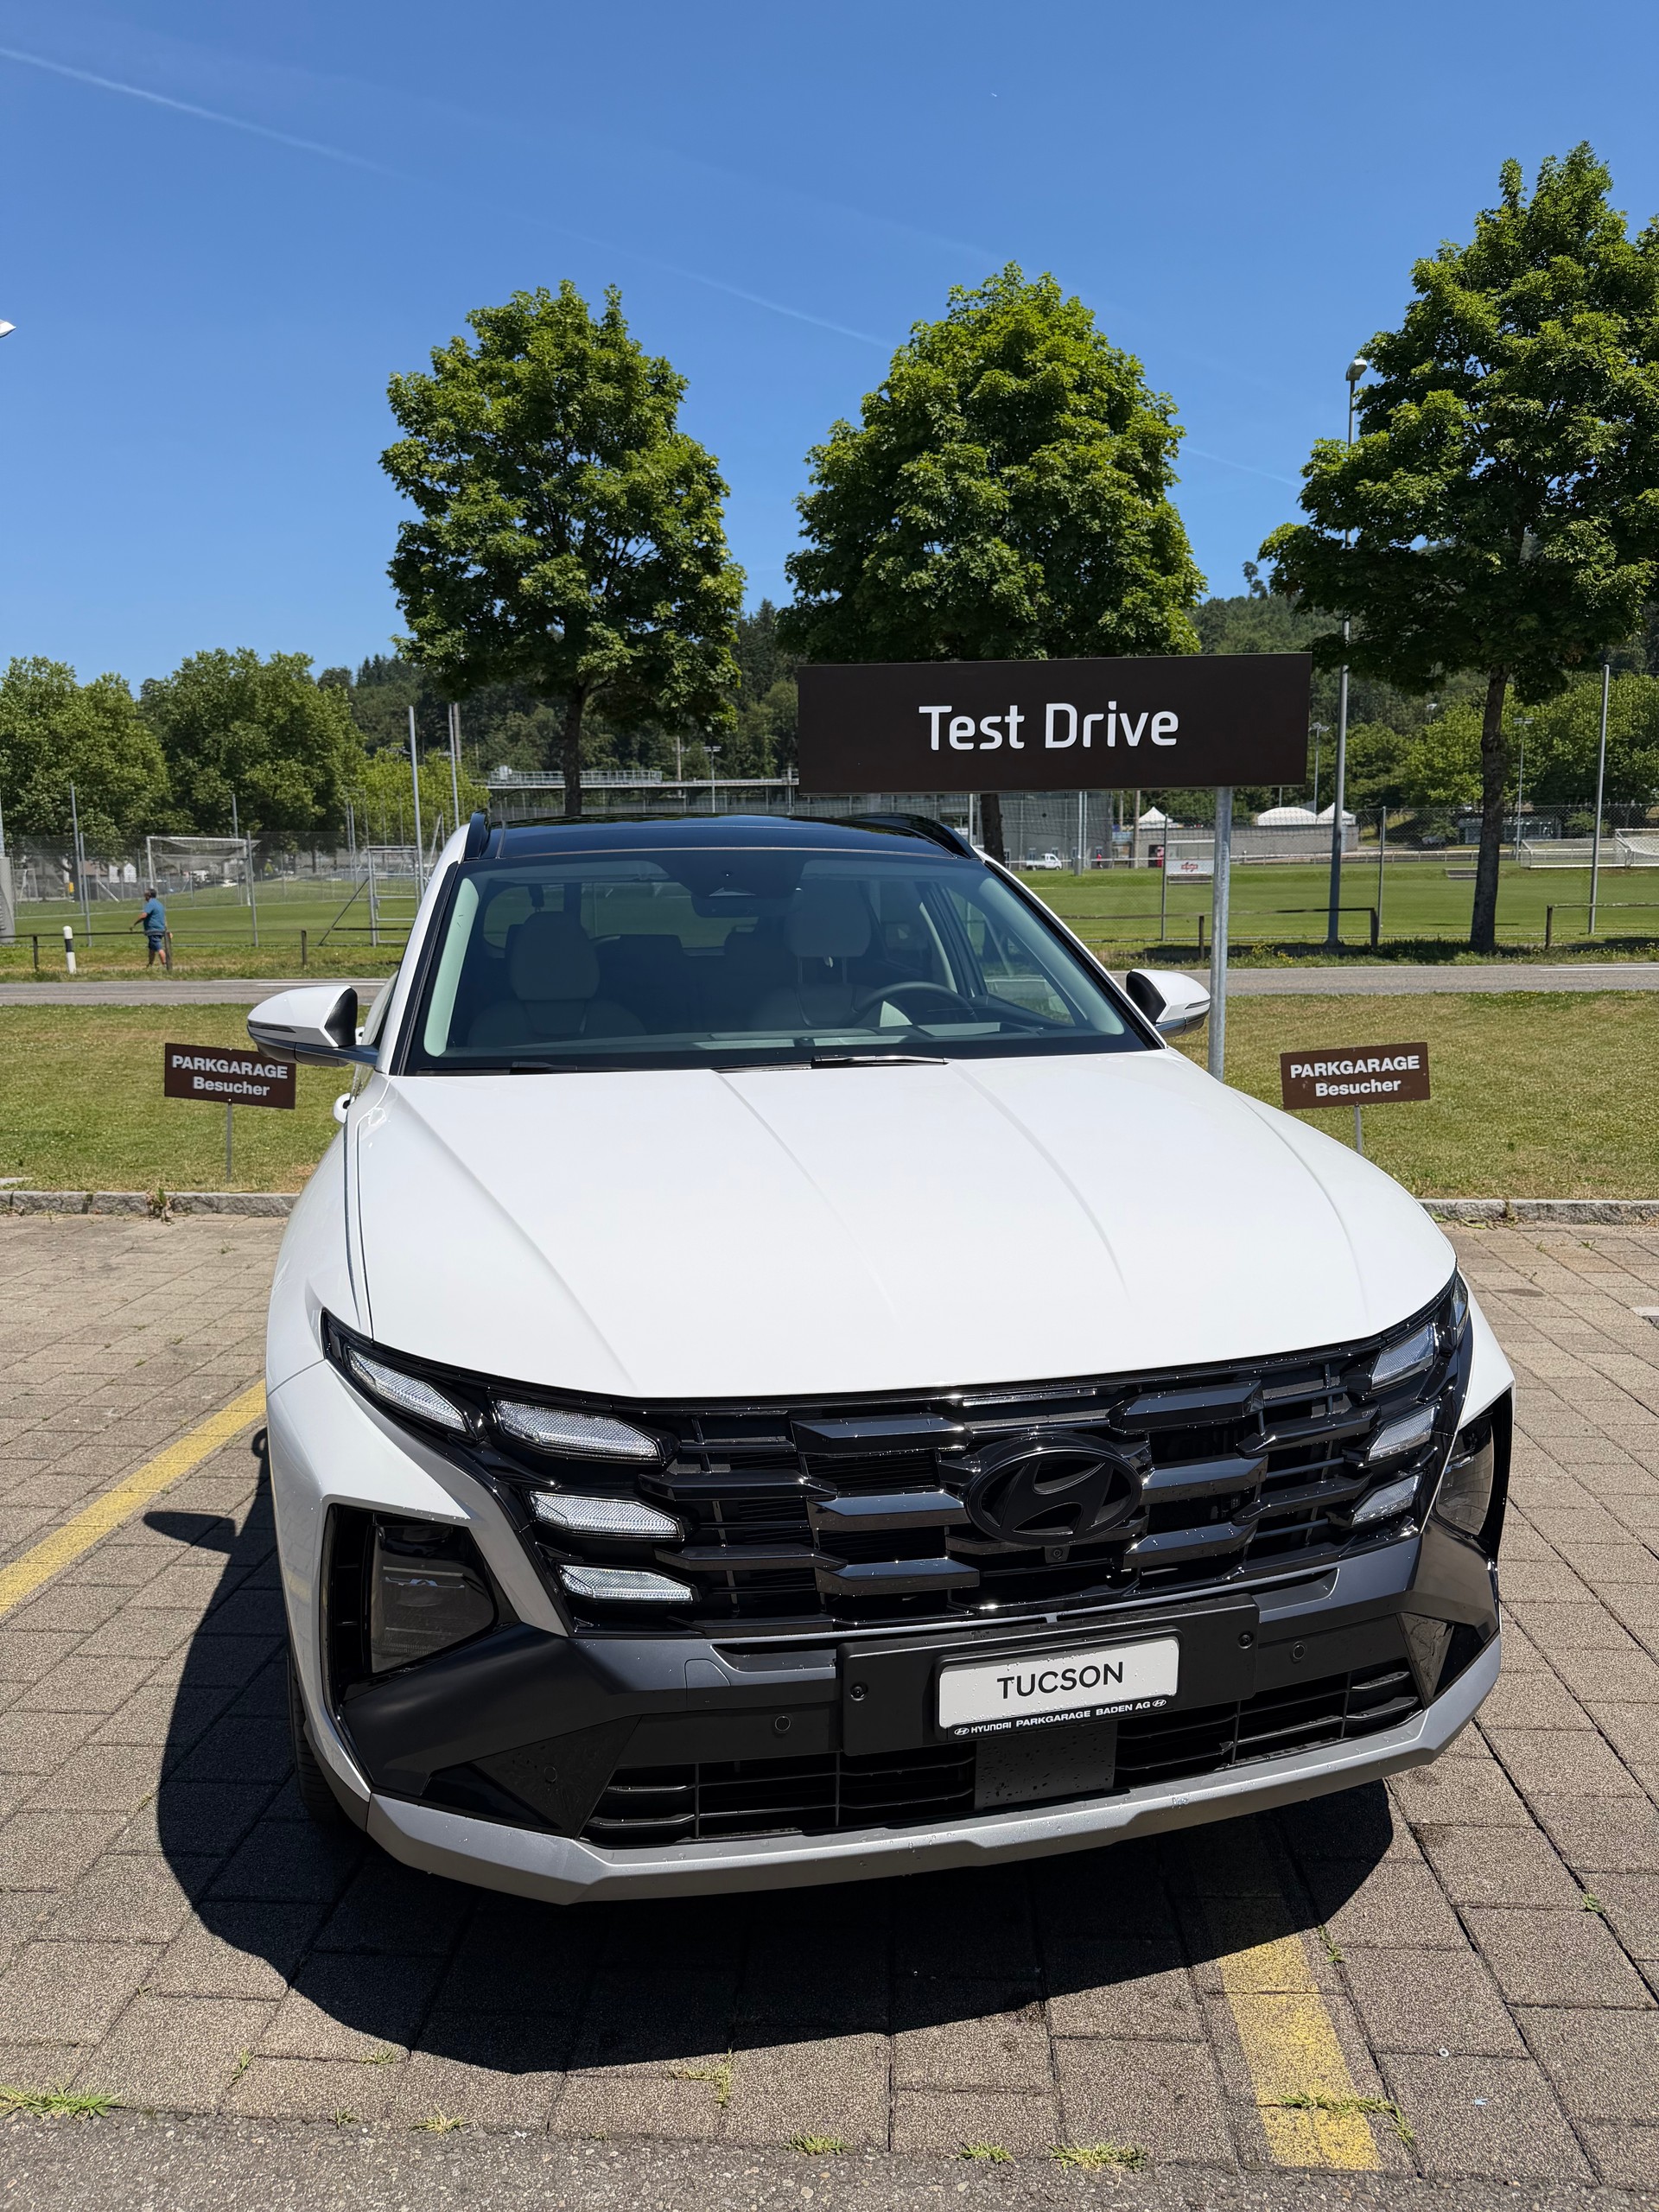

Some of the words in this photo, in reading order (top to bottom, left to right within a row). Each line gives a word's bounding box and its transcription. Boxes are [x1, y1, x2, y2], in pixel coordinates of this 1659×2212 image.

[918, 704, 1025, 751] Test
[1045, 700, 1179, 749] Drive
[171, 1054, 288, 1079] PARKGARAGE
[1290, 1055, 1421, 1078] PARKGARAGE
[193, 1076, 270, 1096] Besucher
[1315, 1078, 1402, 1096] Besucher
[996, 1661, 1123, 1700] TUCSON
[970, 1721, 1012, 1733] HYUNDAI
[1015, 1710, 1090, 1727] PARKGARAGE
[1096, 1703, 1133, 1716] BADEN
[1135, 1700, 1151, 1710] AG
